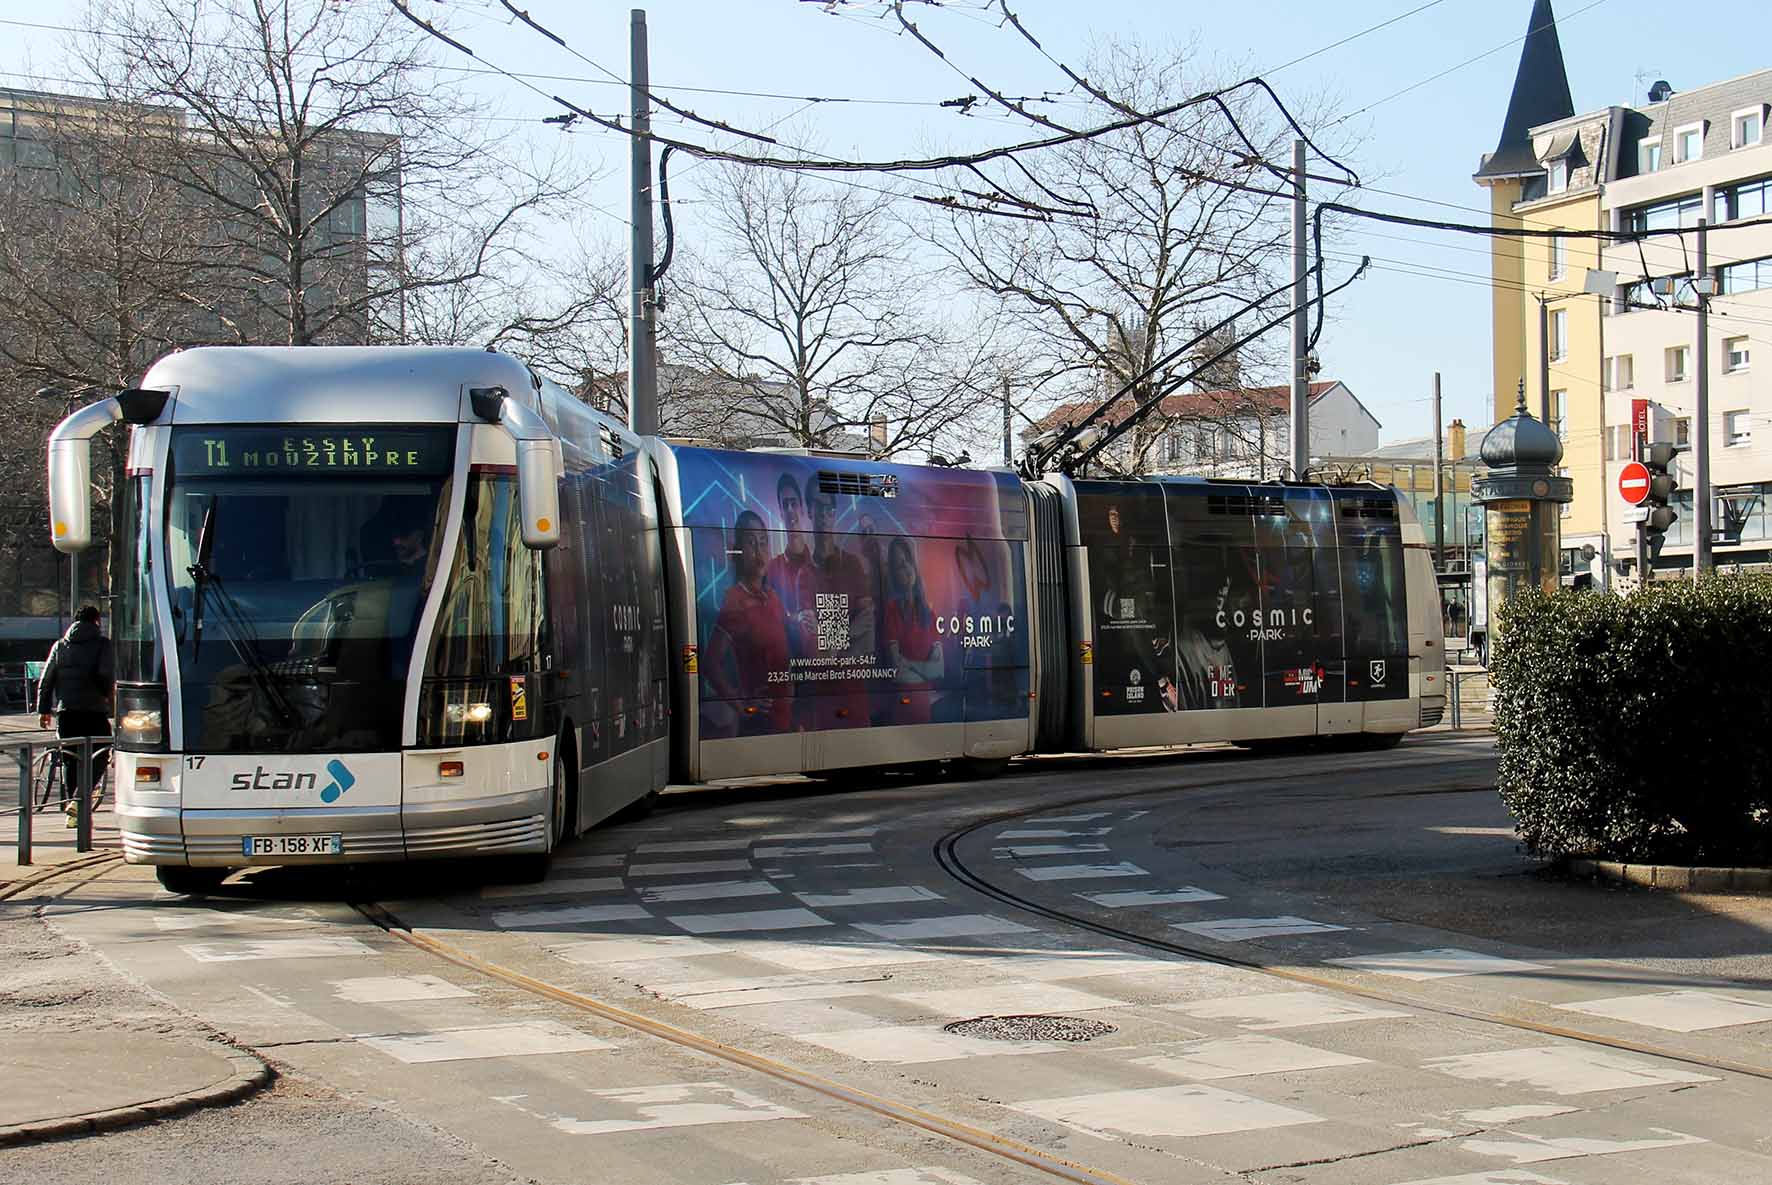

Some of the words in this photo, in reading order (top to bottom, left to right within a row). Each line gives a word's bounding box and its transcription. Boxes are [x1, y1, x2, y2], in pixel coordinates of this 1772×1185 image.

[284, 437, 375, 452] ESSEY
[204, 439, 230, 467] T1
[244, 451, 419, 466] MOUZIMPRE
[935, 615, 1015, 634] COSMIC
[1216, 608, 1313, 628] COSMIC
[790, 655, 877, 667] www.cosmic-park-54.fr
[767, 671, 789, 683] 23,25
[804, 670, 829, 680] Marcel
[830, 670, 845, 680] Brot
[846, 669, 871, 679] 54000
[872, 668, 897, 678] NANCY
[185, 756, 206, 770] 17
[230, 766, 317, 791] stan
